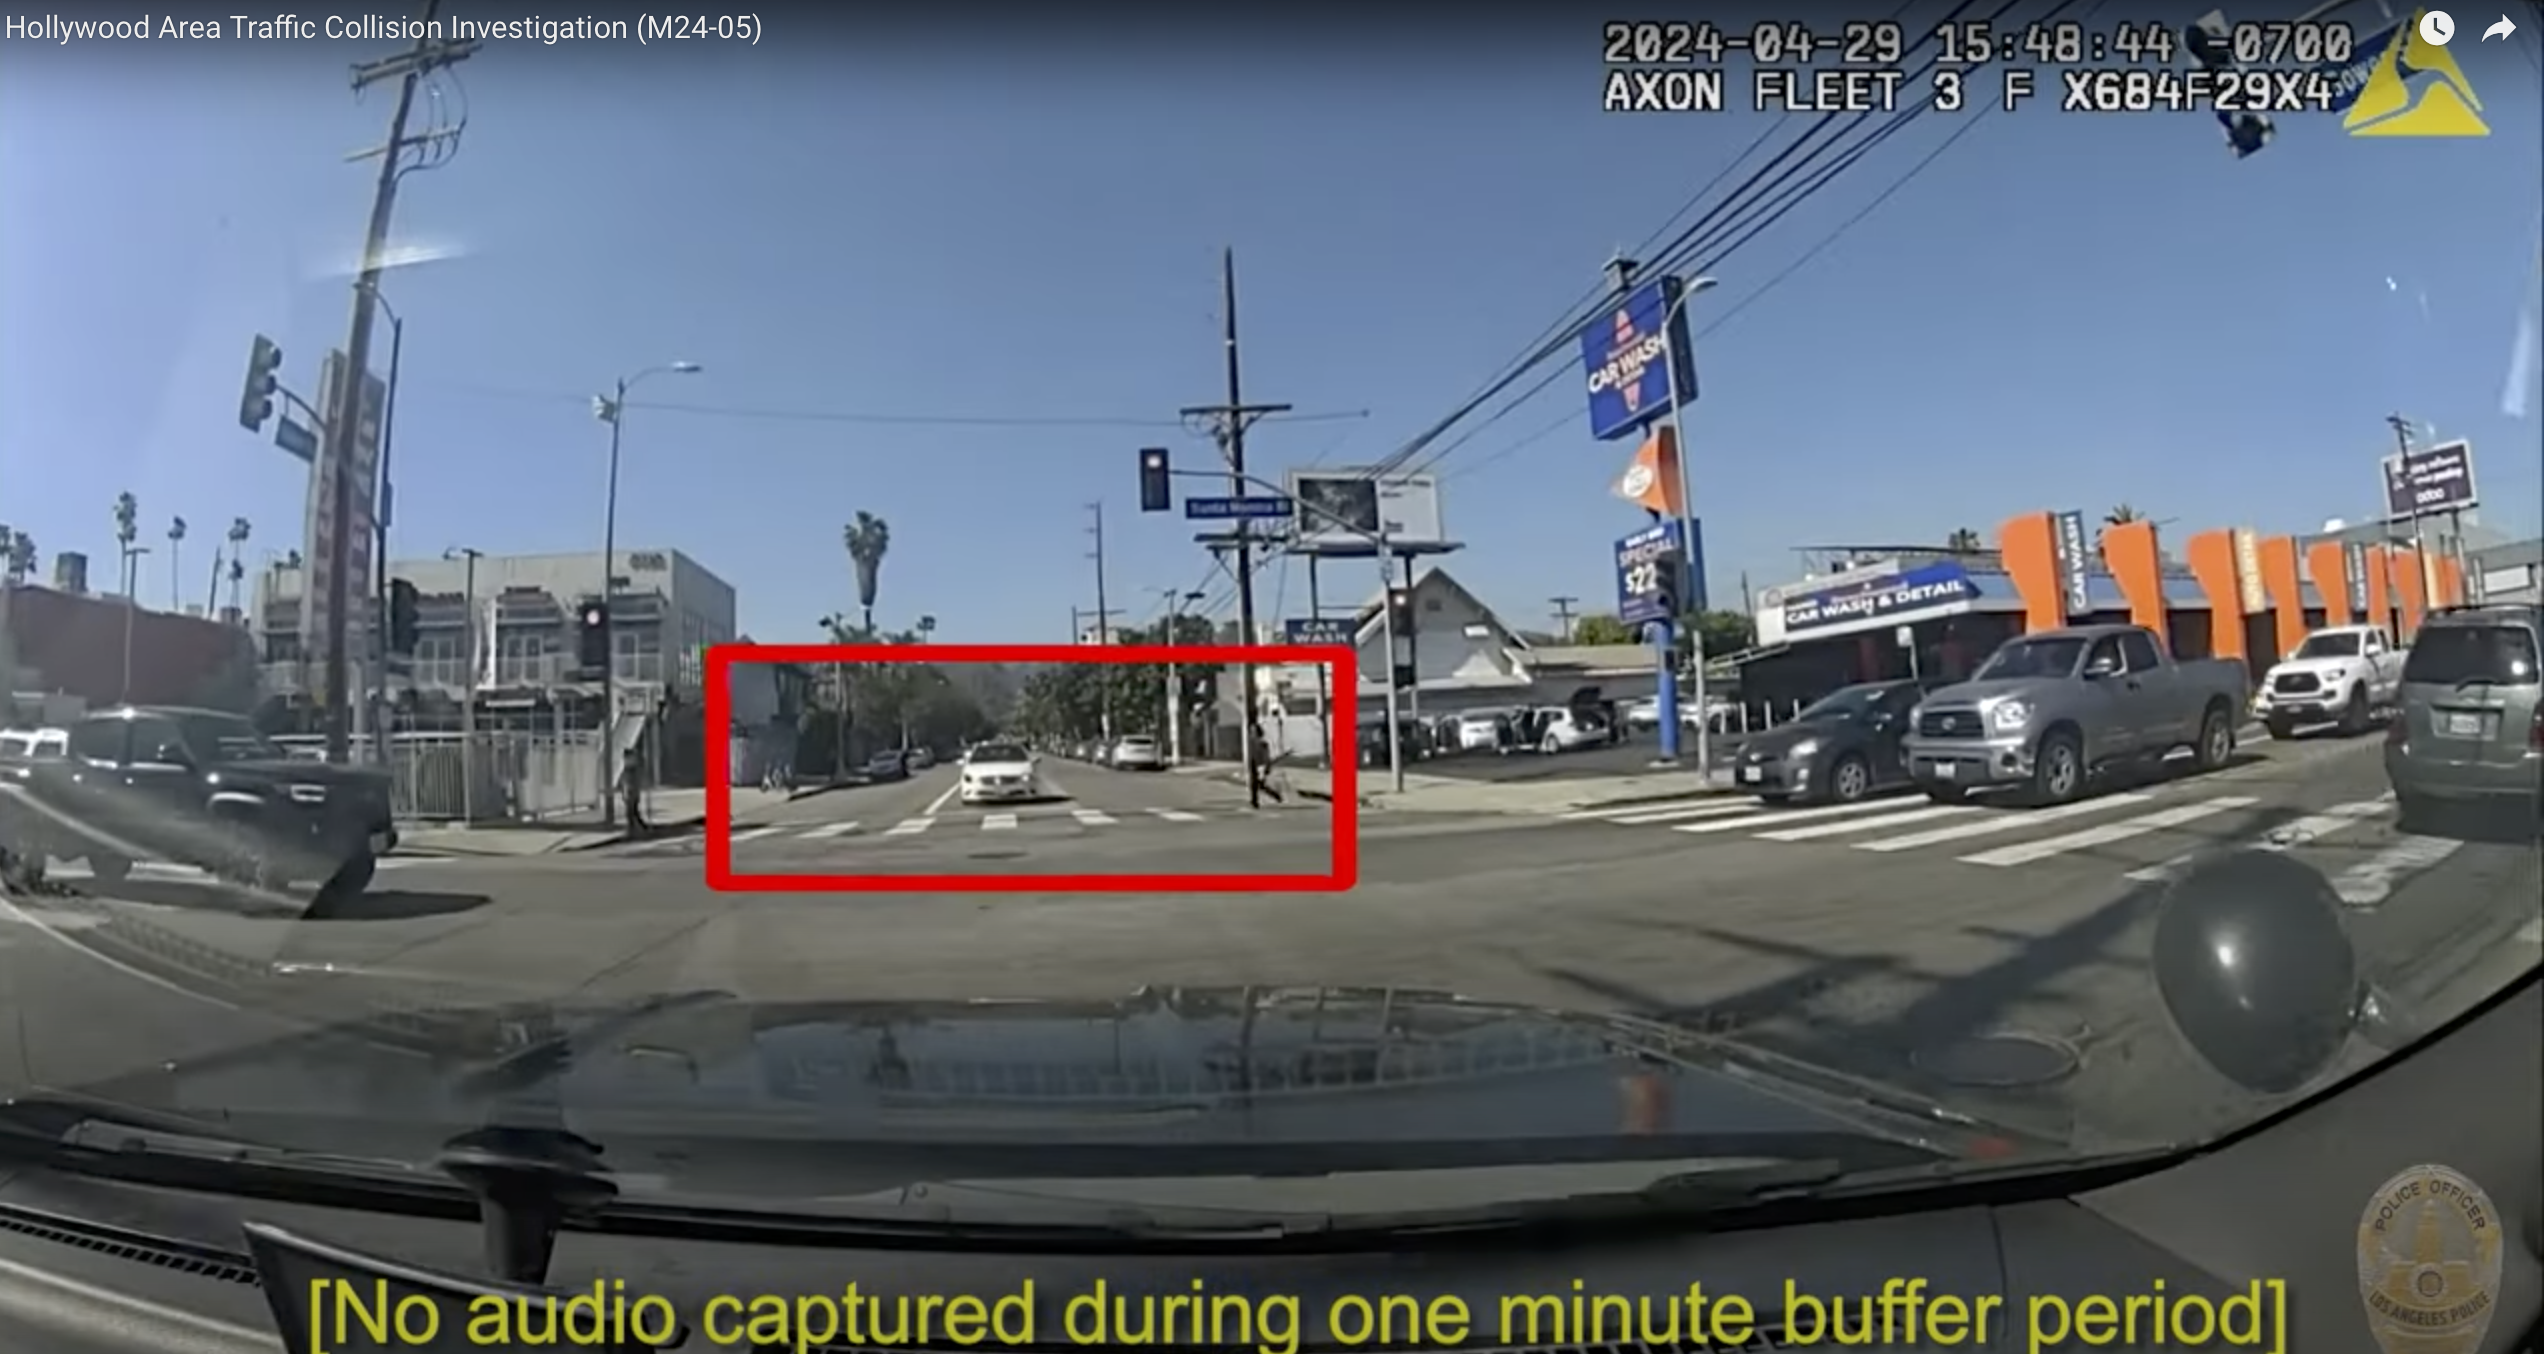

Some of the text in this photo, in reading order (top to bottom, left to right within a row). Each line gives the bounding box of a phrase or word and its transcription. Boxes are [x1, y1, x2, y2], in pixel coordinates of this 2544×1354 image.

[1589, 362, 1620, 393] CAR
[1625, 562, 1657, 594] $22
[2065, 516, 2086, 609] CAR WASH
[1786, 607, 1820, 625] CAR
[1821, 600, 1874, 618] WASH
[1877, 595, 1893, 608] &
[1896, 580, 1965, 604] DETAIL
[1293, 633, 1347, 645] WASH
[1302, 622, 1338, 632] CAR
